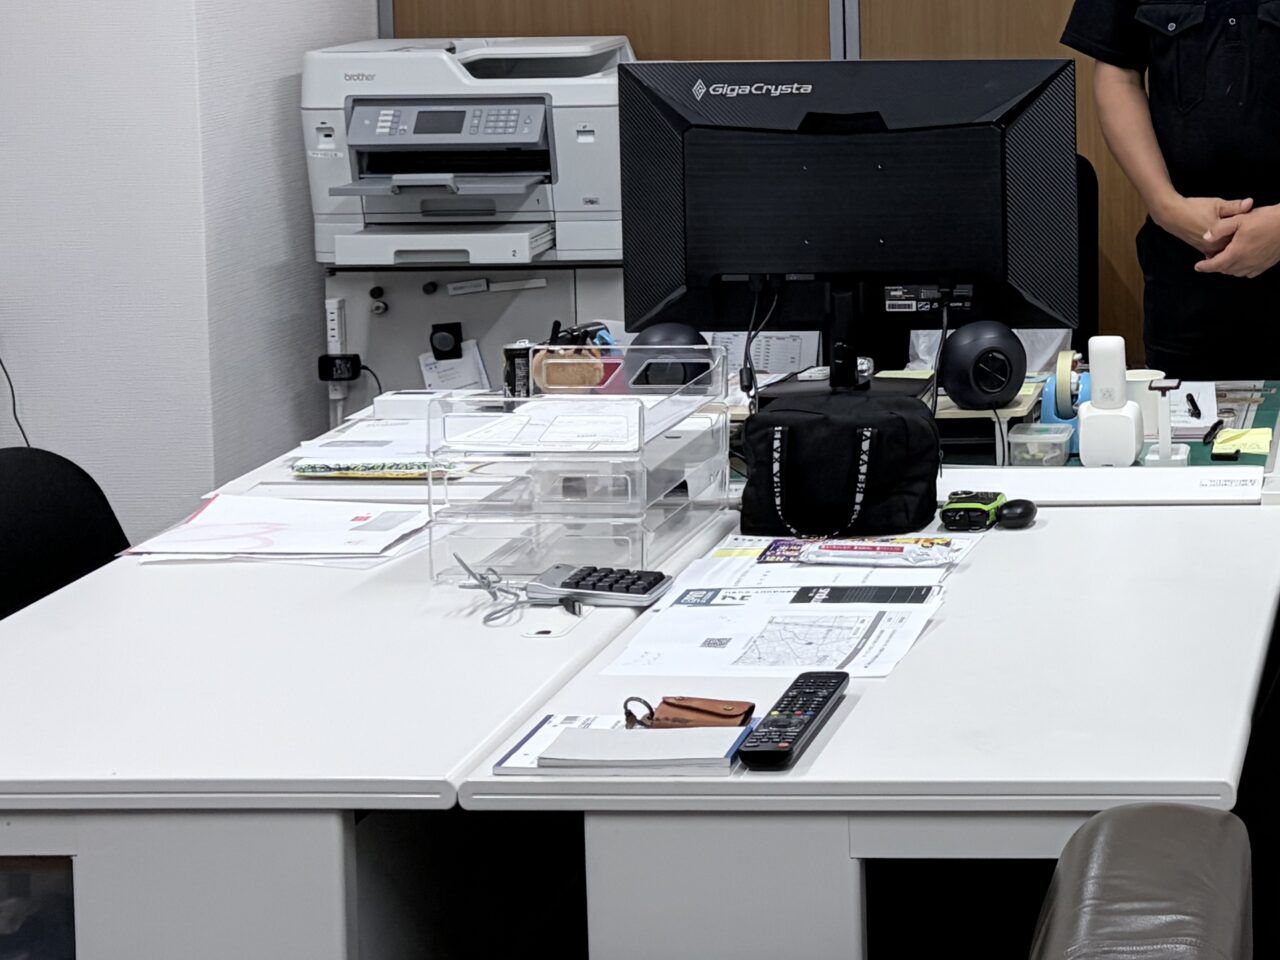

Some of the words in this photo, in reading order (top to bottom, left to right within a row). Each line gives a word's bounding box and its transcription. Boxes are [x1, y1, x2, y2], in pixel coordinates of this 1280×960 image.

[344, 72, 376, 82] brother
[709, 81, 812, 97] GigaCrysta
[511, 249, 517, 258] 2
